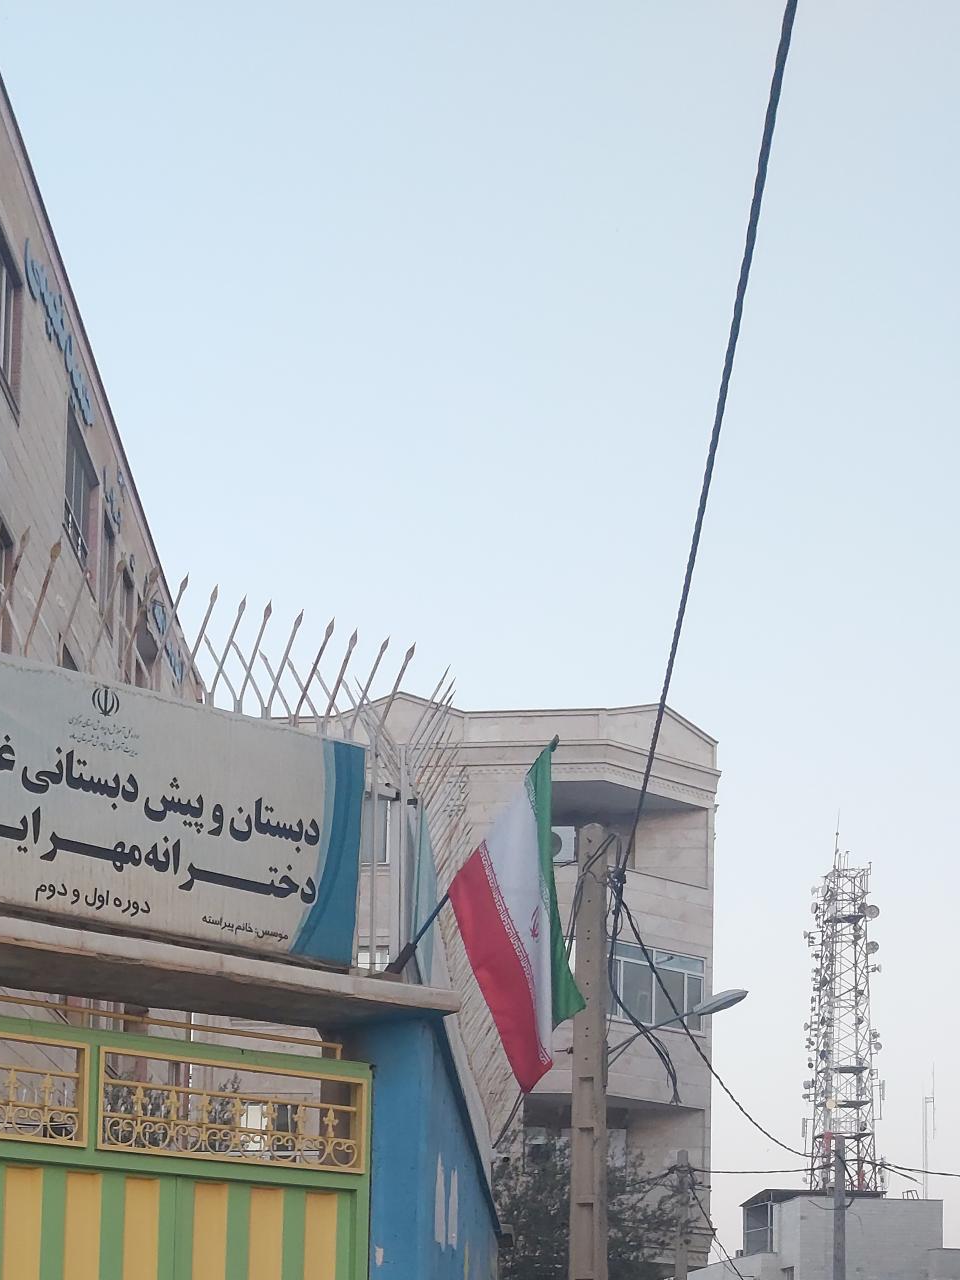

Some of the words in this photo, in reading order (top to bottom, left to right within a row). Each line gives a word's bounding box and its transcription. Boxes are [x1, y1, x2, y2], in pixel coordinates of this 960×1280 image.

[21, 746, 138, 810] دبستانی
[144, 777, 204, 834] پیش
[207, 803, 224, 836] و
[230, 797, 319, 853] دبستان
[144, 836, 317, 904] دخترانه
[35, 881, 67, 901] دوم
[72, 888, 80, 905] و
[85, 887, 109, 910] اول
[114, 897, 151, 917] دوره
[202, 914, 234, 931] پیراسته
[234, 922, 253, 934] خانم
